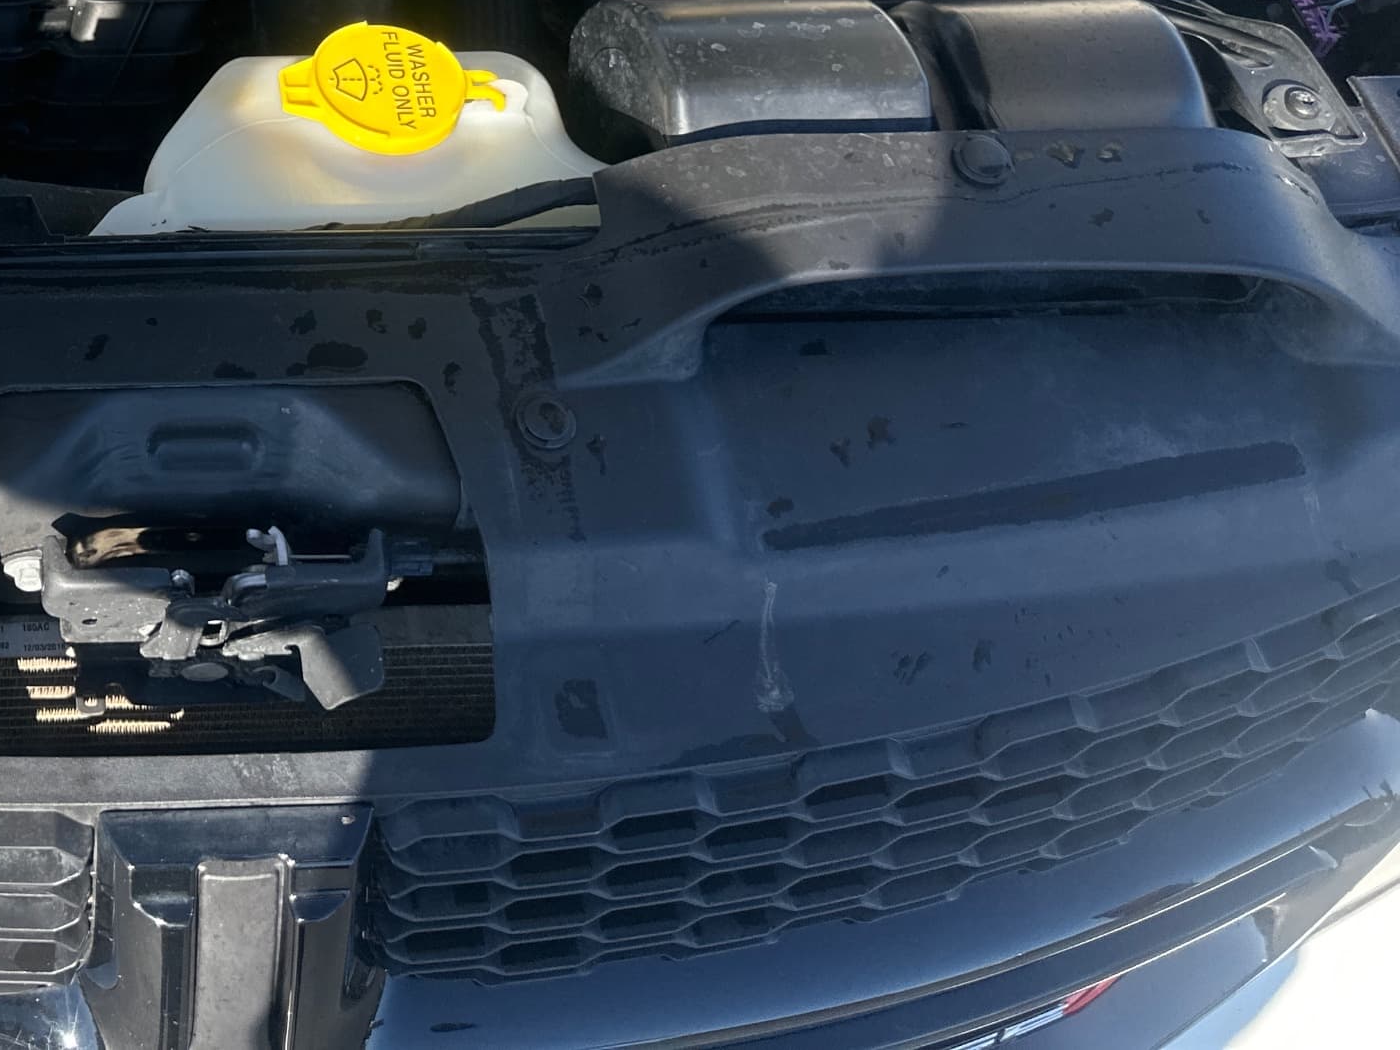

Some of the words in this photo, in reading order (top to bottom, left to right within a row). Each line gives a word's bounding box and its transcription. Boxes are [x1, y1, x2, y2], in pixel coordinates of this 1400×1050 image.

[381, 31, 406, 80] FLUID
[405, 43, 438, 118] WASHER
[391, 86, 418, 130] ONLY
